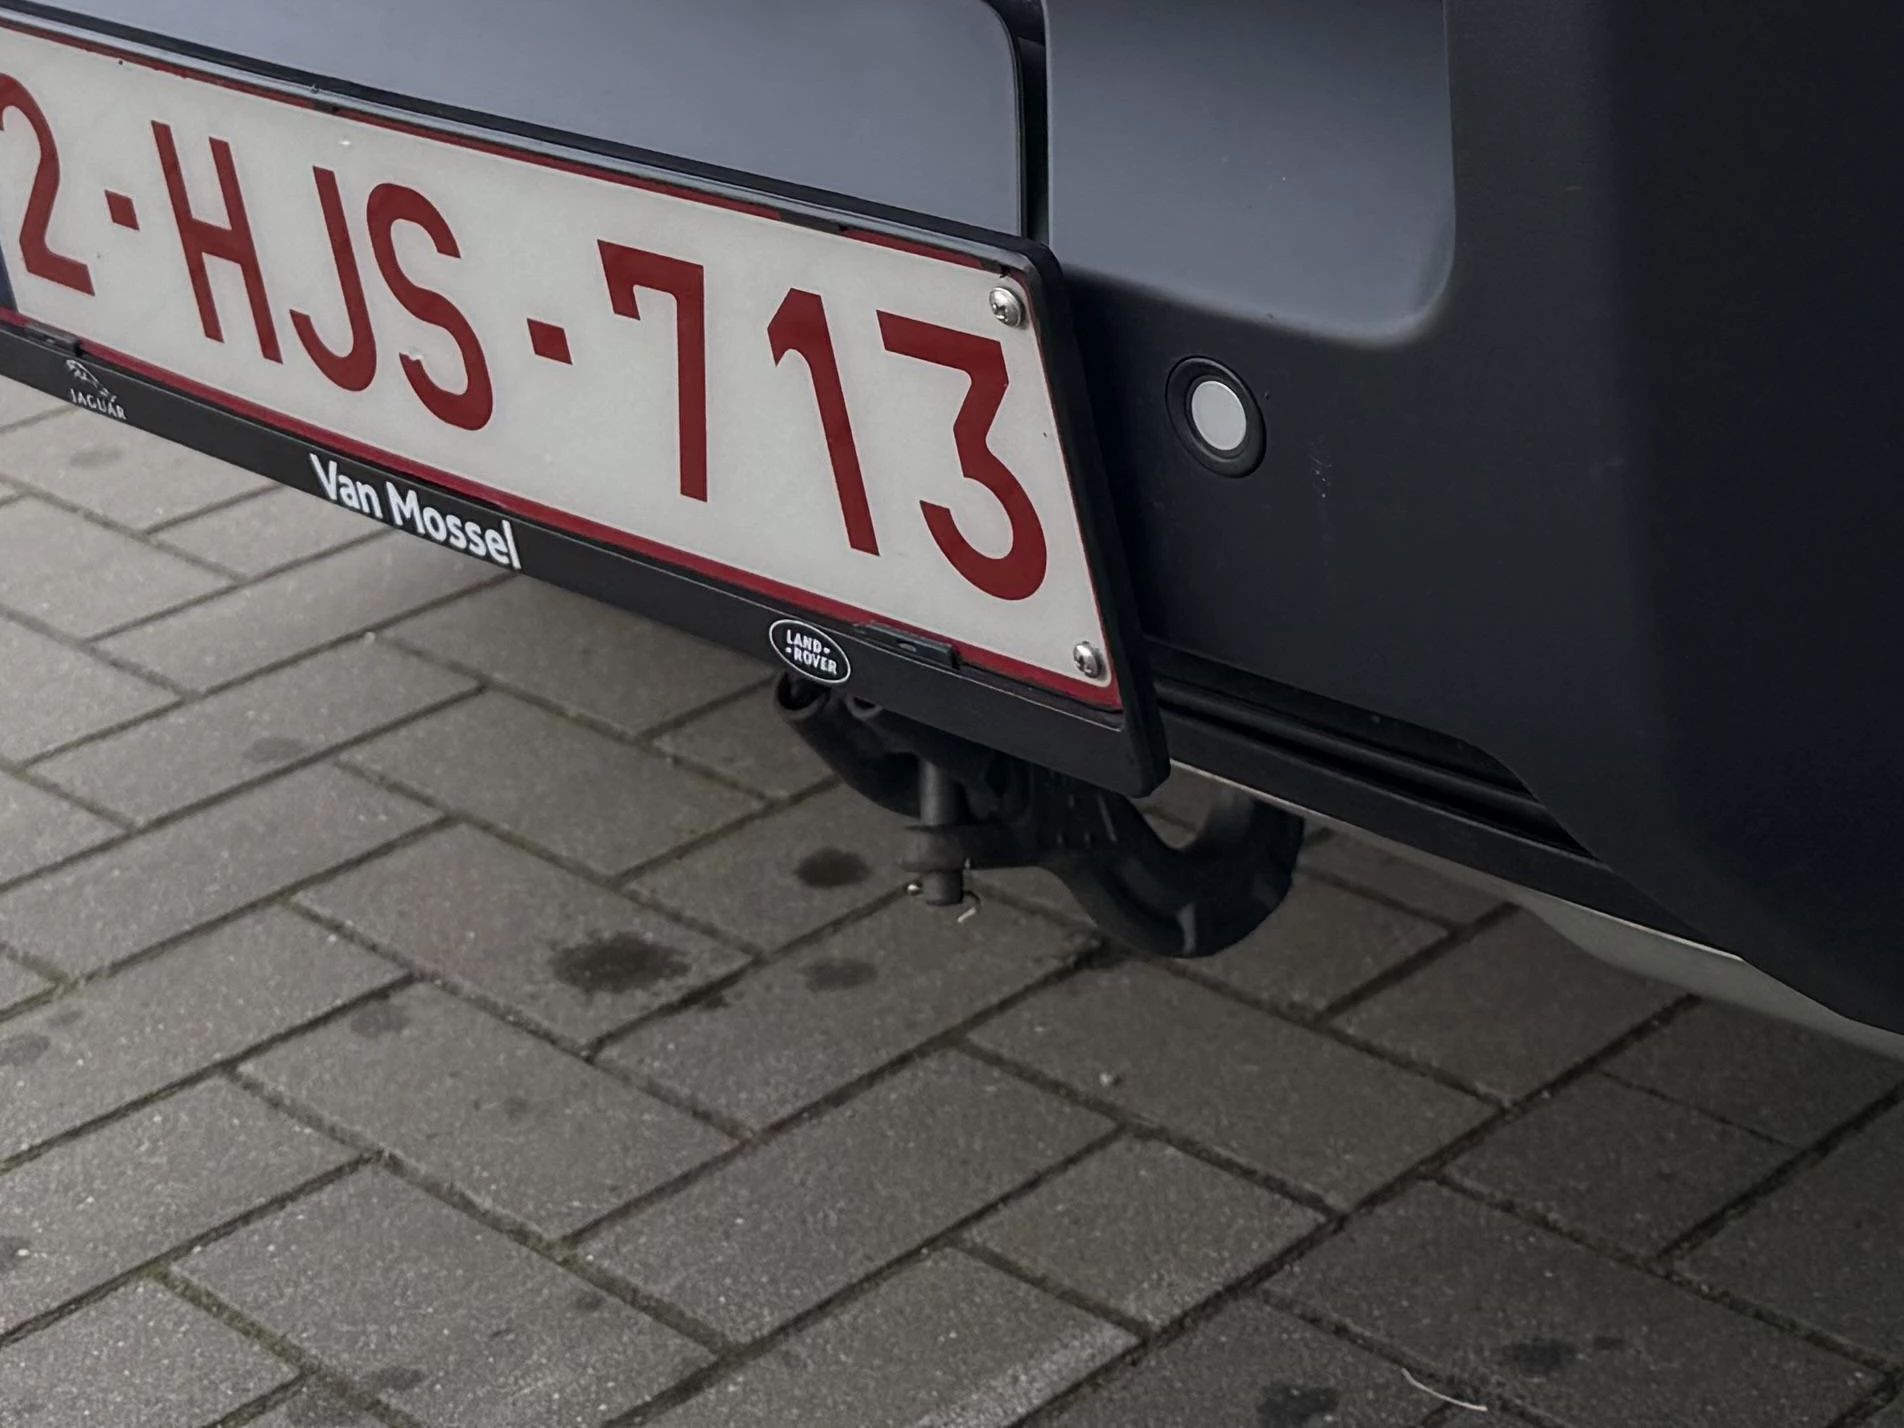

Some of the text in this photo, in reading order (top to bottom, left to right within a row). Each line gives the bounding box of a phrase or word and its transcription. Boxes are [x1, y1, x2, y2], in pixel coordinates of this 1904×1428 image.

[70, 388, 127, 421] JAGUAR
[308, 452, 523, 571] Van Mossel
